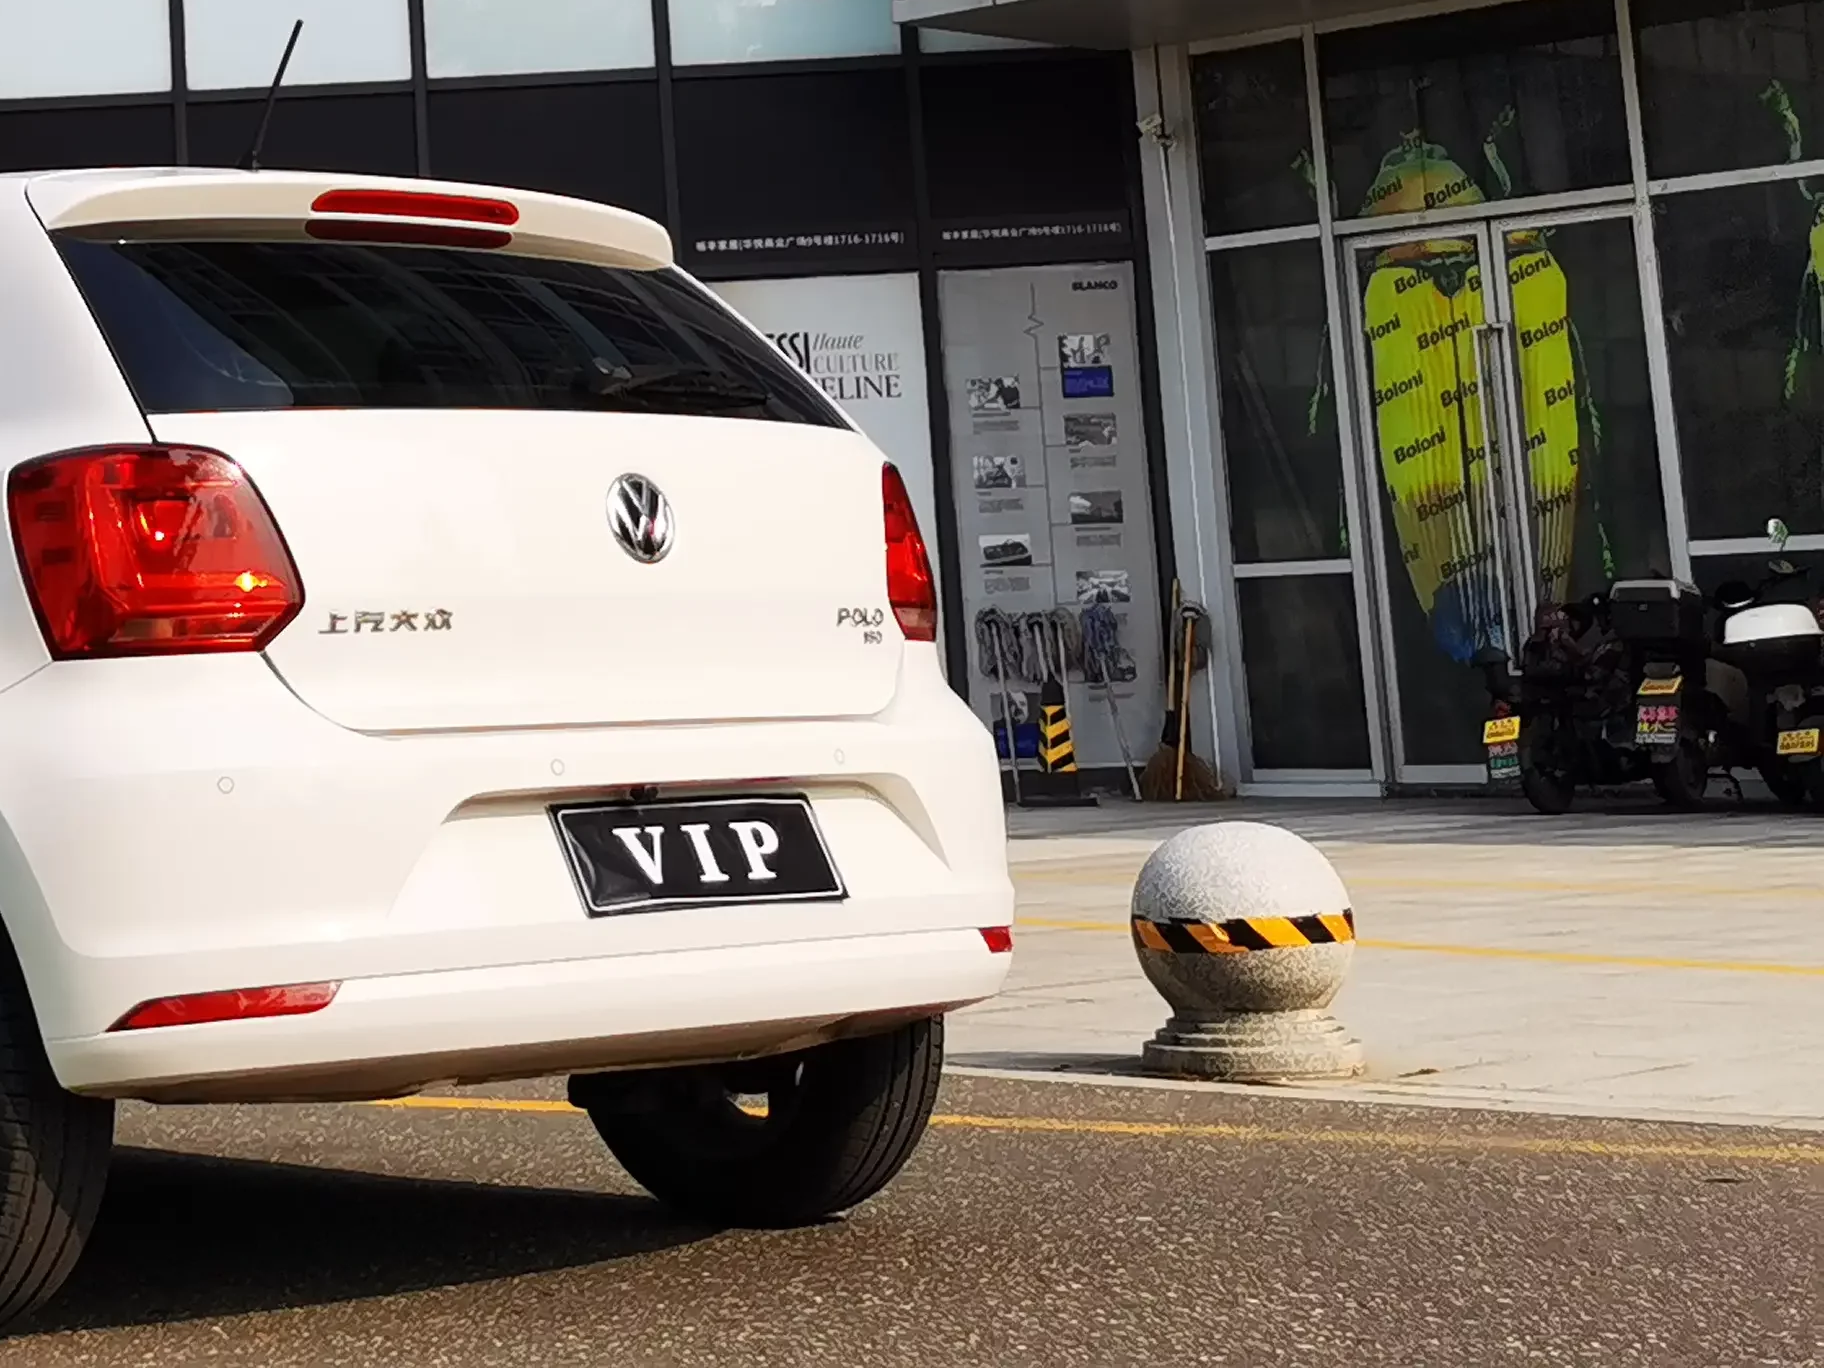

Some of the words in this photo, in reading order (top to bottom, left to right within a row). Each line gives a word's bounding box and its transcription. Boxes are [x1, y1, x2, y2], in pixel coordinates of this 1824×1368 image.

[812, 332, 864, 351] Haute
[1416, 312, 1471, 352] Boloni
[814, 352, 900, 375] CULTURE
[1393, 425, 1446, 465] Boloni
[318, 608, 453, 635] 上汽大众
[836, 607, 884, 627] POLO
[612, 819, 779, 884] VIP
